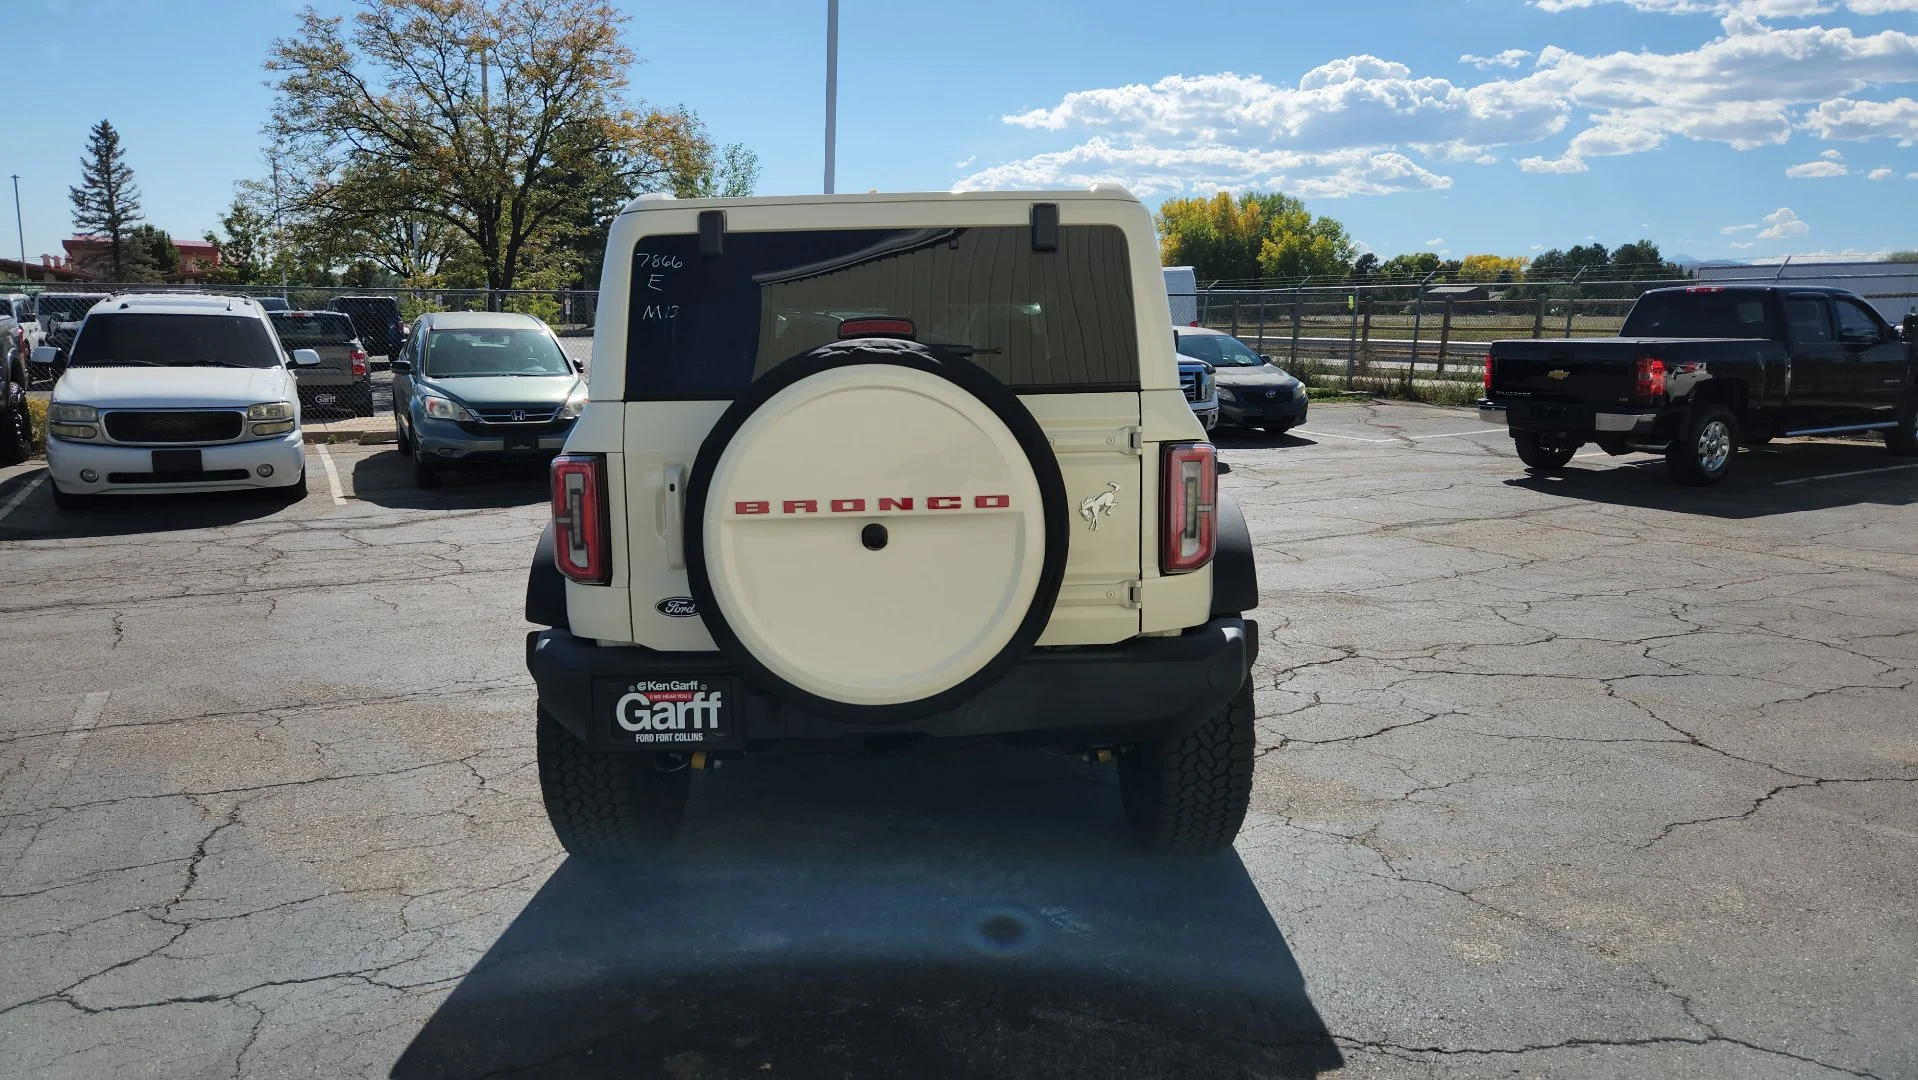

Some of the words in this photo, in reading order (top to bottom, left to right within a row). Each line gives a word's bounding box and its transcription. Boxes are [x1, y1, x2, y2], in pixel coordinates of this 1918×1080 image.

[637, 253, 683, 268] 7866
[648, 274, 664, 291] E
[735, 495, 1010, 515] BRONCO
[665, 600, 696, 613] Ford
[647, 681, 670, 691] Ken
[670, 680, 698, 690] Garff
[616, 691, 722, 731] Garff
[635, 734, 654, 742] FORD
[655, 733, 674, 742] FORT
[674, 732, 703, 742] COLLINS
